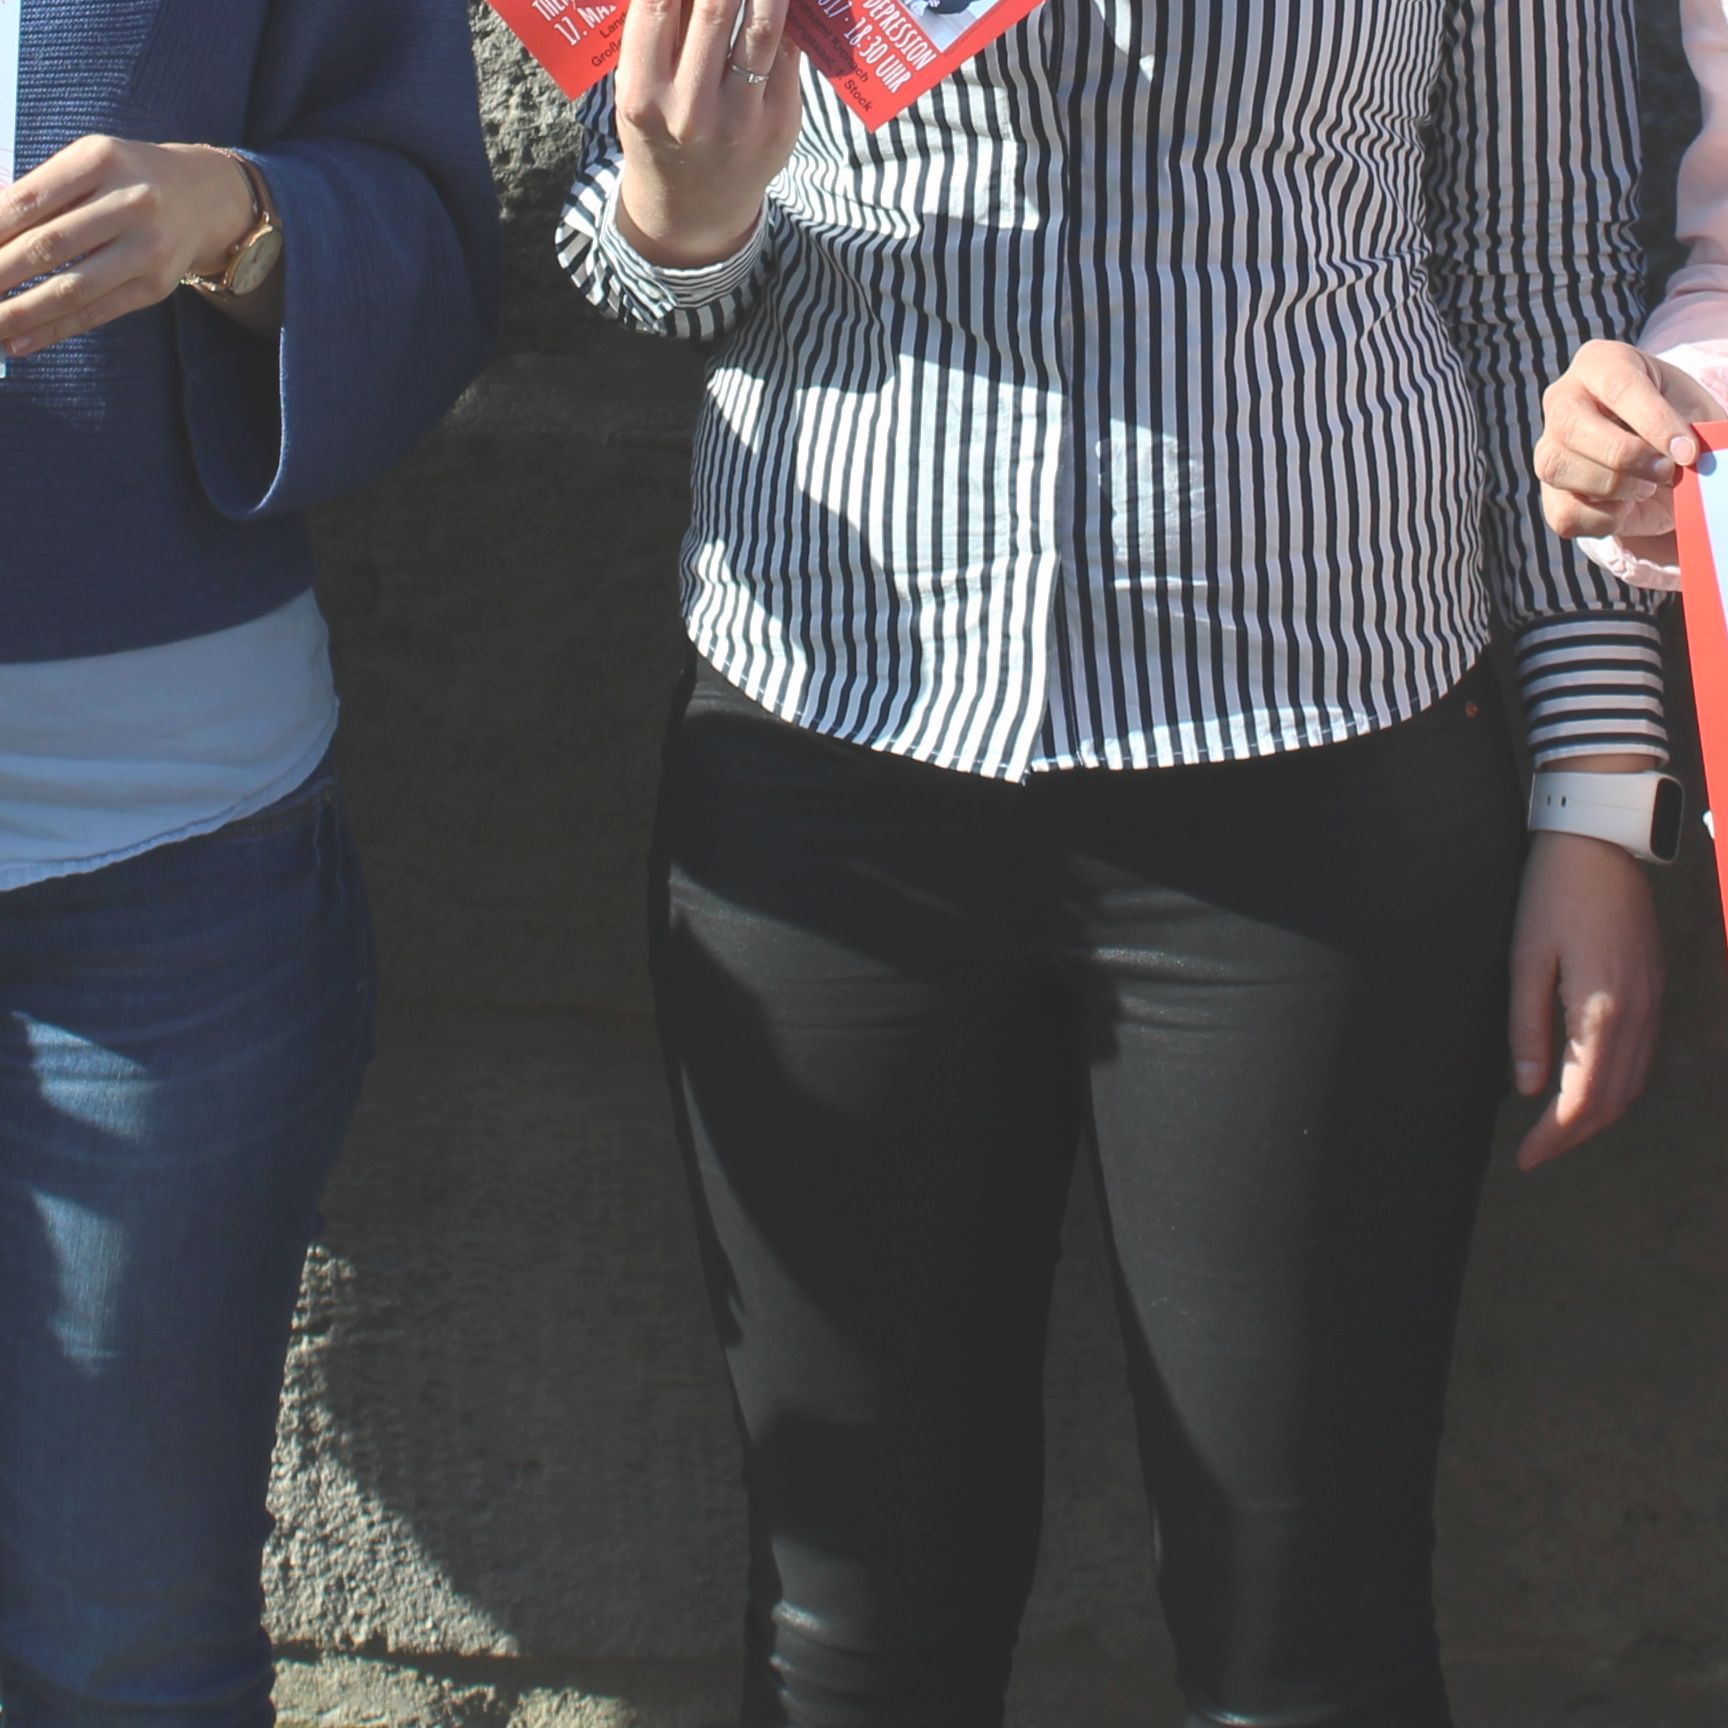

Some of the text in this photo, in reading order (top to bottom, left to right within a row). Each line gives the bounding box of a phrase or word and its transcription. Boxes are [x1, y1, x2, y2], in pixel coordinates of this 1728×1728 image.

[554, 16, 588, 47] 17.
[844, 17, 889, 64] 18:30
[875, 54, 912, 93] UHR
[844, 79, 872, 112] Stock
